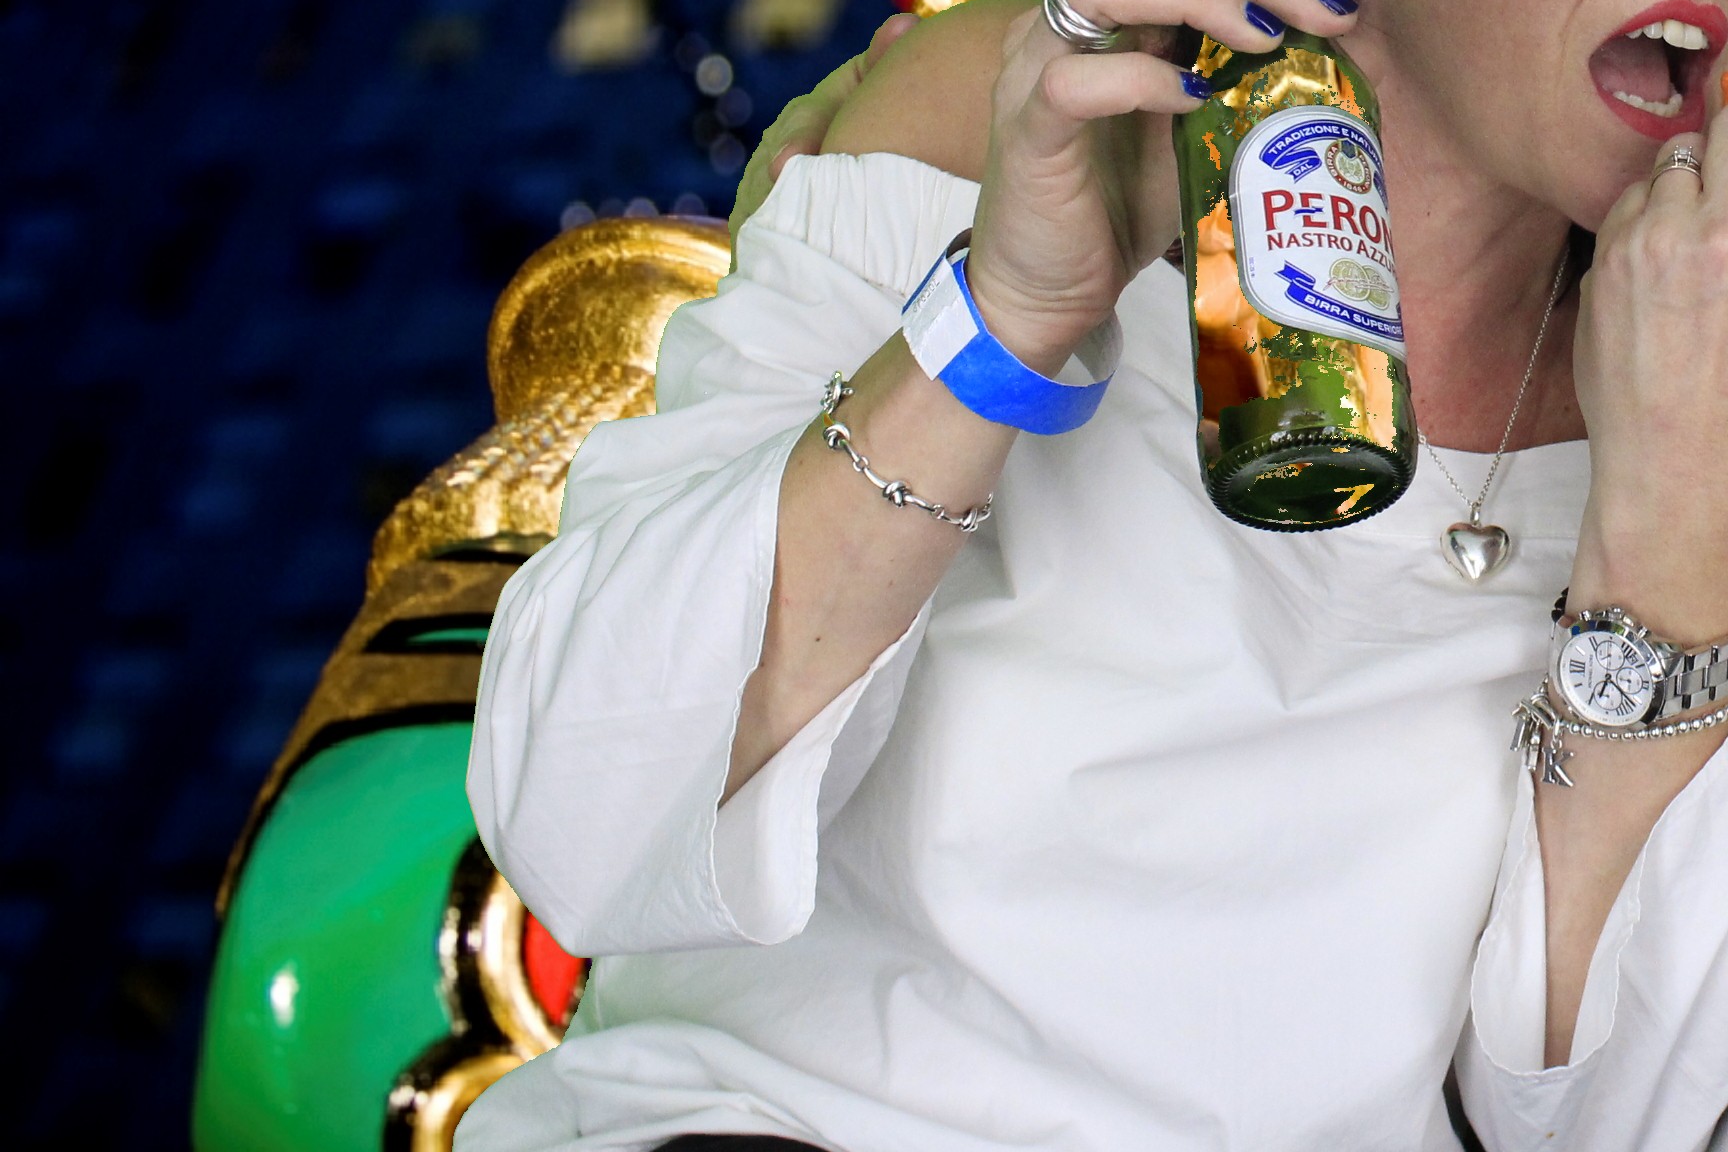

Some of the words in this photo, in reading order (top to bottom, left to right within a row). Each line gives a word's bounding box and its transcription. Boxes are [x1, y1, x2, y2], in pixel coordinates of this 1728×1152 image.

[1269, 125, 1340, 155] TRADIZIONE
[1342, 128, 1349, 136] E
[1293, 162, 1313, 178] DAL
[1326, 146, 1338, 177] BIRRA
[1262, 189, 1395, 256] PERON
[1267, 232, 1351, 252] NASTRO
[1304, 294, 1350, 319] BIRRA
[1541, 747, 1574, 787] K
